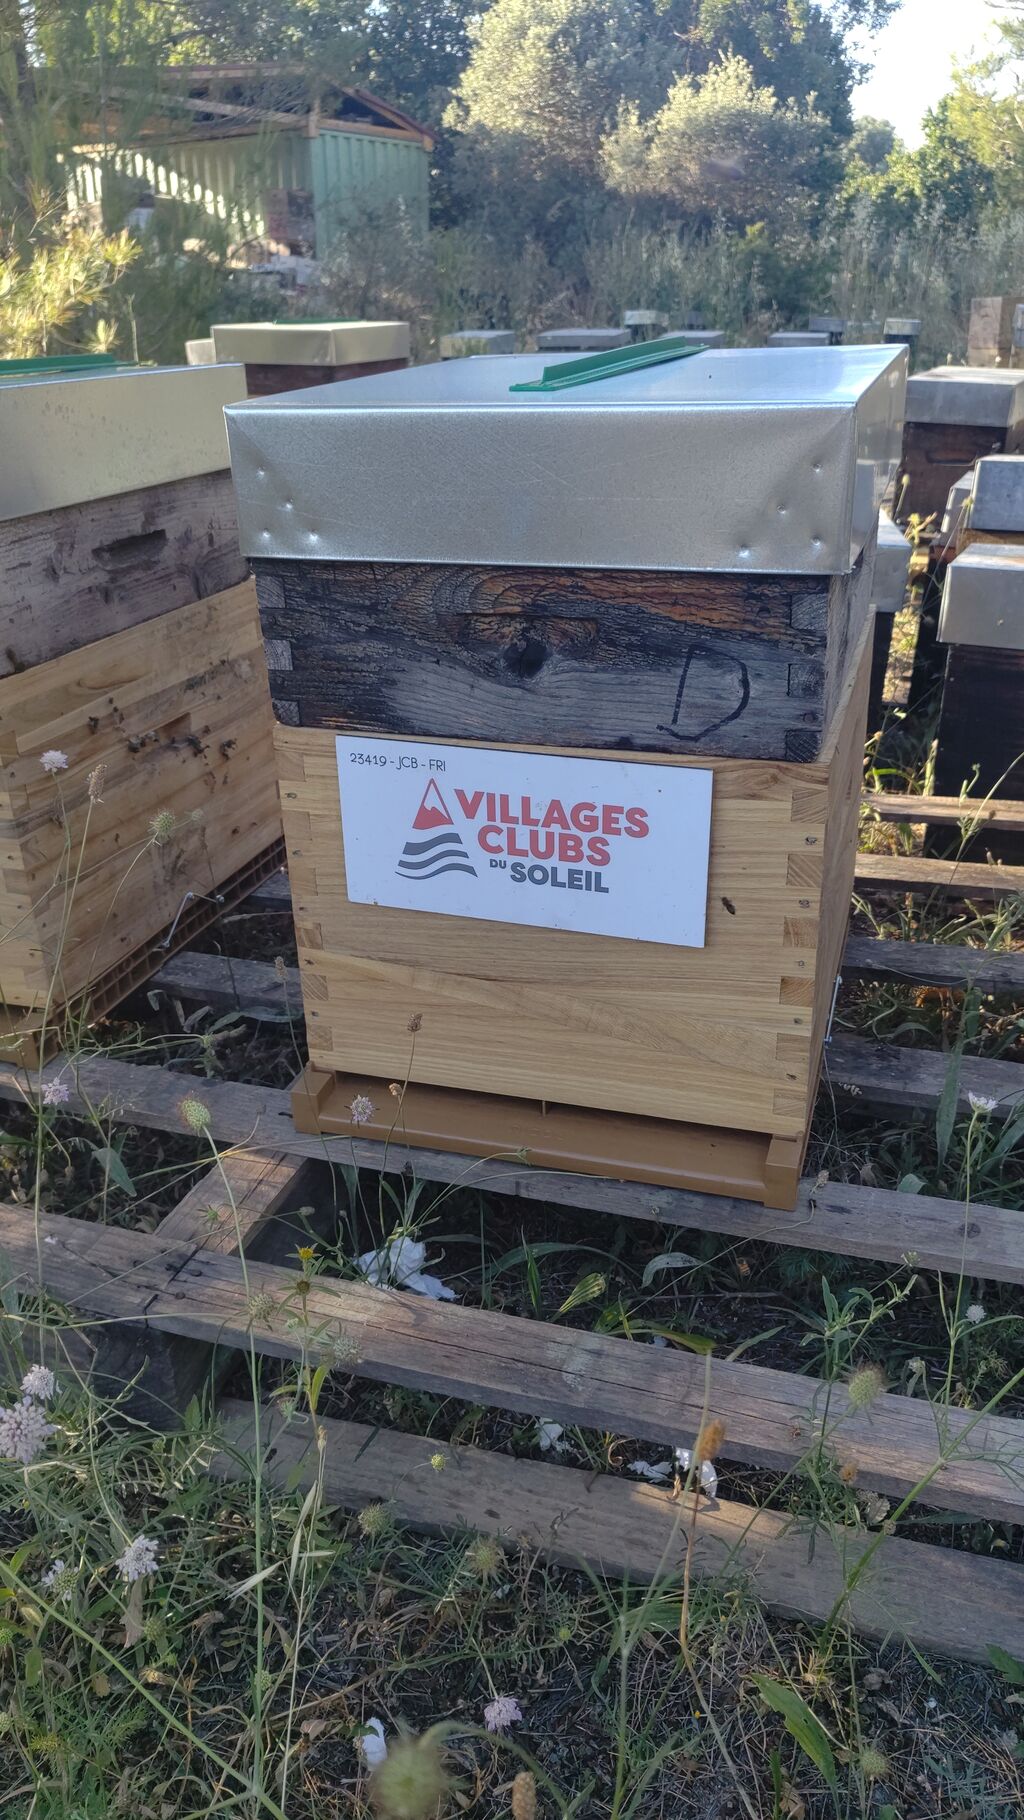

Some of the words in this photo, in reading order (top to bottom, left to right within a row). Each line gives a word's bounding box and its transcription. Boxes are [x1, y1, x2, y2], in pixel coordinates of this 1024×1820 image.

[454, 789, 649, 838] VILLAGES
[478, 825, 611, 866] CLUBS
[489, 858, 507, 869] DU
[510, 862, 609, 893] SOLEIL
